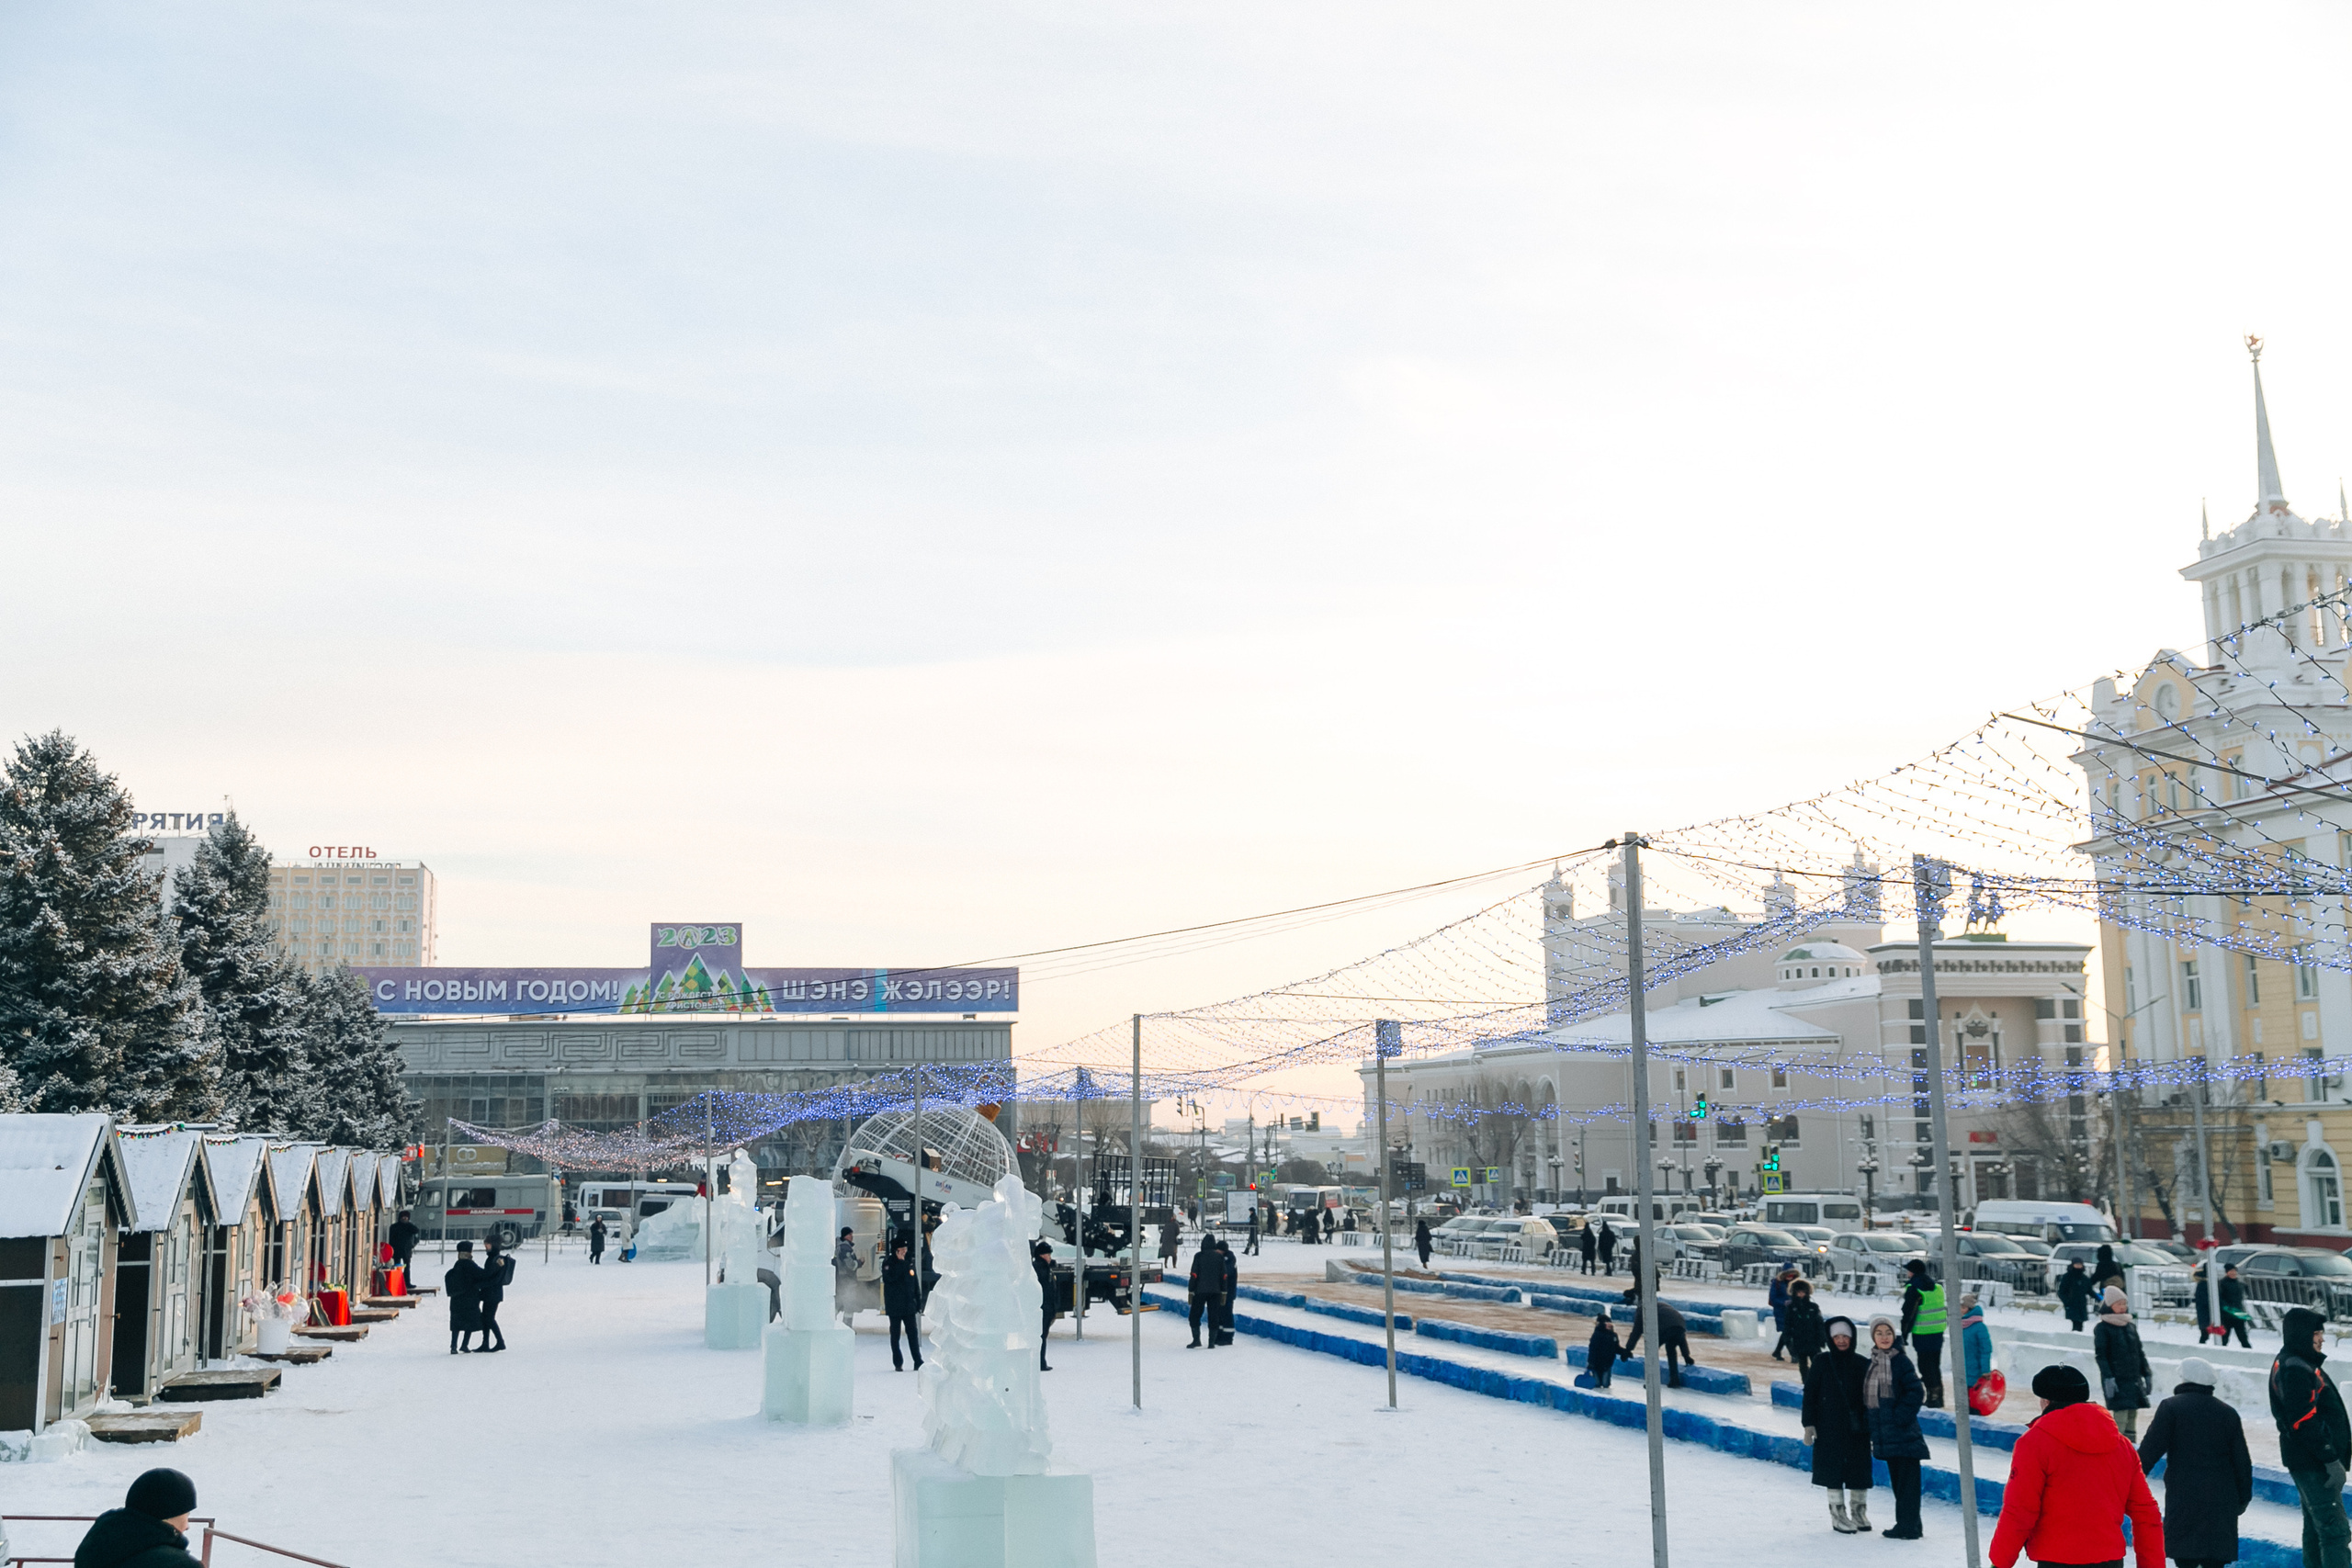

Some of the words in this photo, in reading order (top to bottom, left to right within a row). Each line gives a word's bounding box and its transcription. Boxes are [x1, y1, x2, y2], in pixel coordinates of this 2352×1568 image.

[309, 845, 377, 859] ОТЕЛЬ
[657, 925, 738, 950] 2023
[376, 980, 396, 1001] С
[405, 980, 507, 1001] НОВЫМ
[516, 980, 619, 1004] ГОДОМ!
[659, 991, 665, 999] С
[783, 979, 870, 1002] ШЭНЭ
[880, 979, 1011, 1001] ЖЭЛЭЭР!
